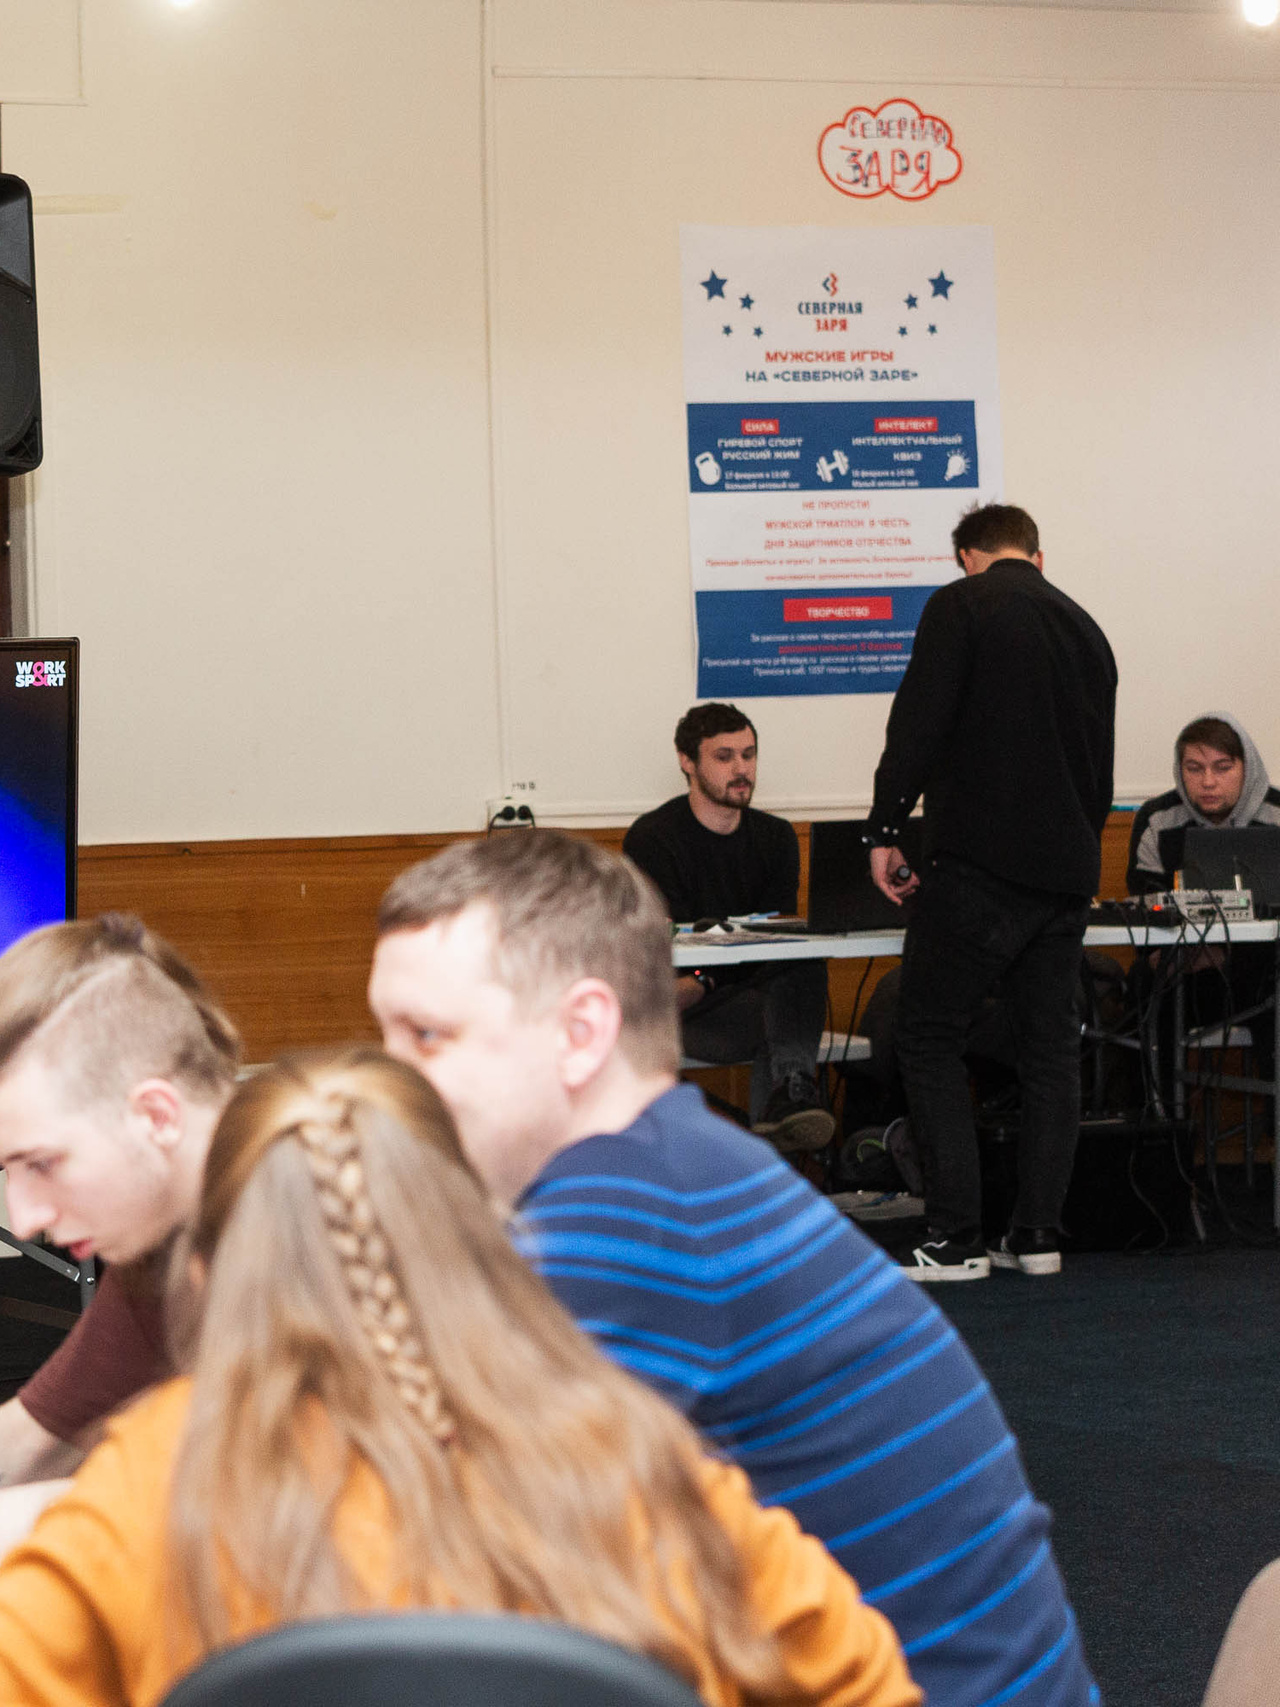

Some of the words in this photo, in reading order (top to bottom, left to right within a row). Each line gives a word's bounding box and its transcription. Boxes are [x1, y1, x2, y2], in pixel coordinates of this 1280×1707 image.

[836, 145, 934, 192] ЗАРЯ
[797, 301, 863, 315] СЕВЕРНАЯ
[816, 318, 847, 332] ЗАРЯ
[765, 351, 846, 363] МУЖСКИЕ
[850, 350, 894, 362] ИГРЫ
[746, 371, 768, 382] НА
[745, 422, 775, 432] СИЛА
[768, 436, 803, 447] СПОРТ
[722, 448, 771, 460] РУССКИЙ
[773, 450, 800, 460] ЖИМ
[893, 451, 923, 462] КВИЗ
[802, 501, 814, 510] НЕ
